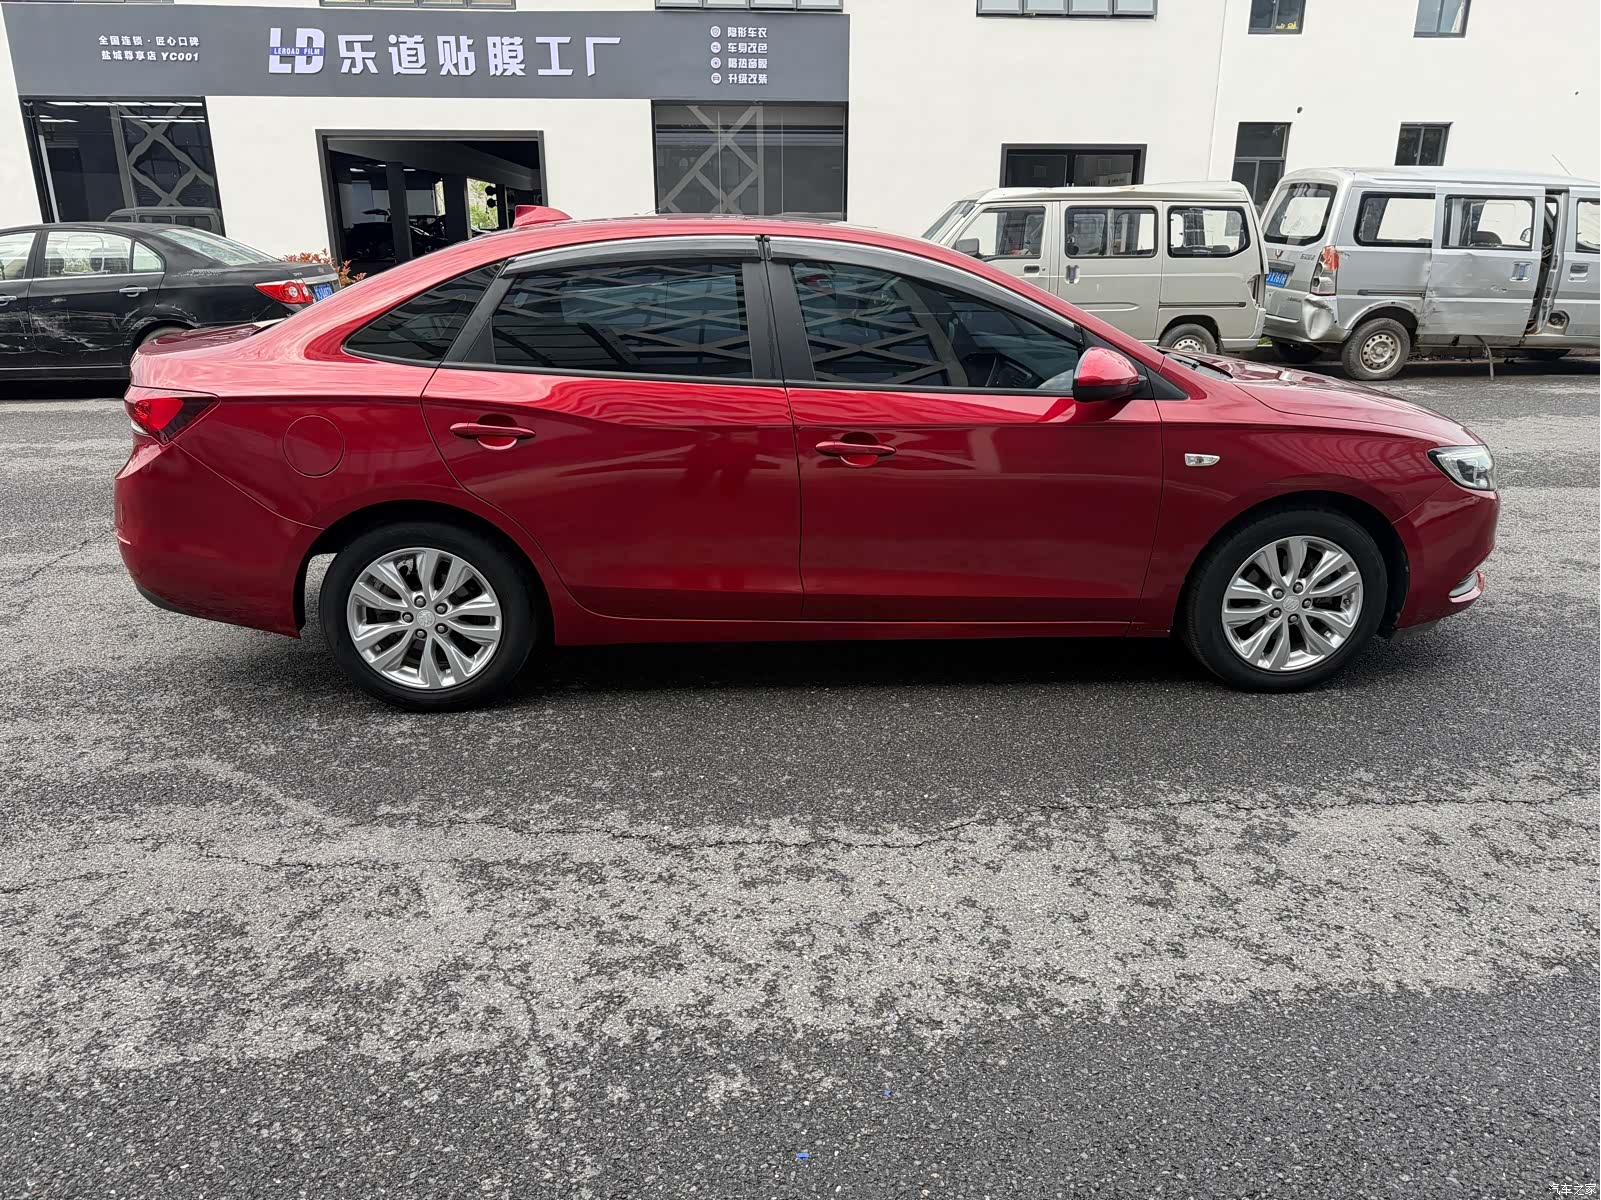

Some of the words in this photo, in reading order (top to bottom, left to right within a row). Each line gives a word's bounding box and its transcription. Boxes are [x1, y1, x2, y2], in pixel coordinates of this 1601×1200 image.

[727, 26, 768, 38] 隐形车衣
[273, 47, 300, 55] LEROAD
[727, 42, 768, 54] 车身改色
[101, 50, 157, 61] 盐城尊享店
[161, 52, 199, 61] YC001
[337, 34, 621, 77] 乐道贴膜工厂
[728, 73, 768, 85] 升级改装
